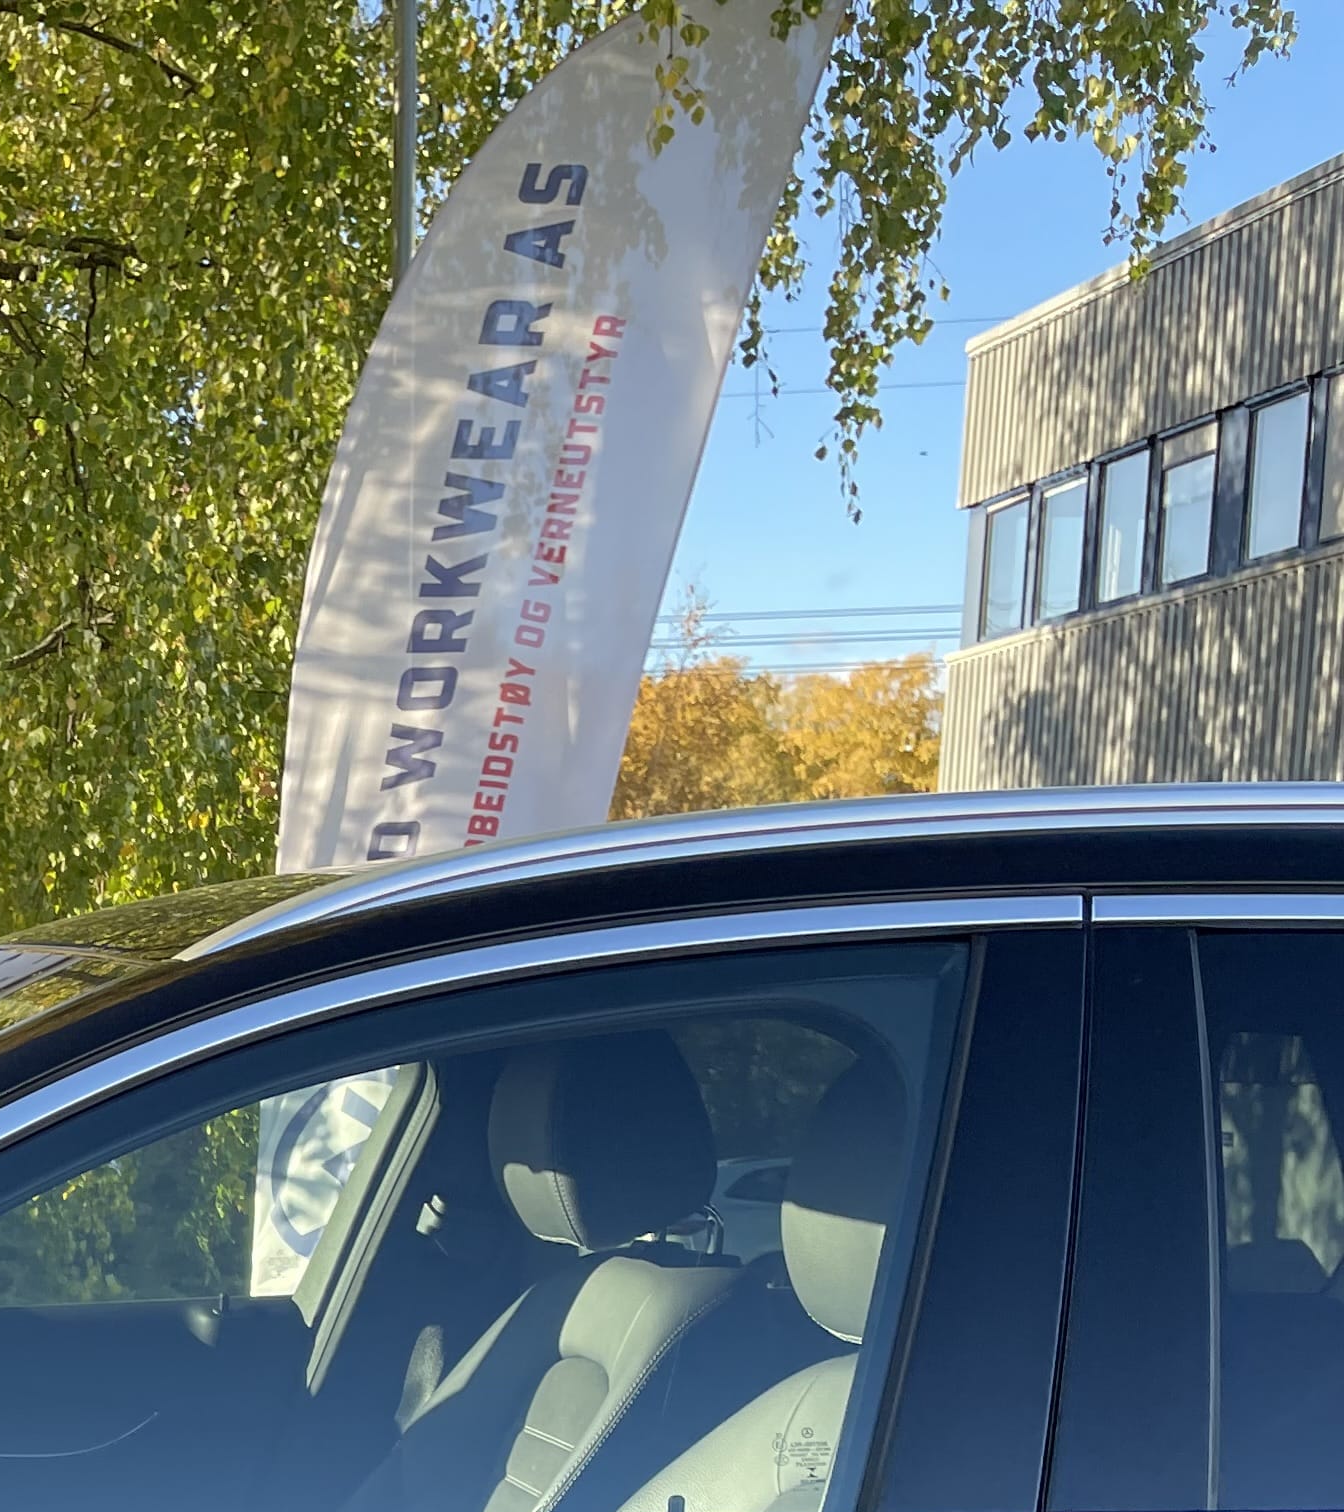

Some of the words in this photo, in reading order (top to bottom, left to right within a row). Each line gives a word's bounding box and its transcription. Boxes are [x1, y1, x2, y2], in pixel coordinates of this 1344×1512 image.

[380, 299, 554, 792] WORKWEAR
[504, 162, 589, 269] AS
[529, 314, 628, 587] VERNEUTSTYR
[517, 600, 553, 650] OG
[464, 656, 537, 848] BEIDSTØY
